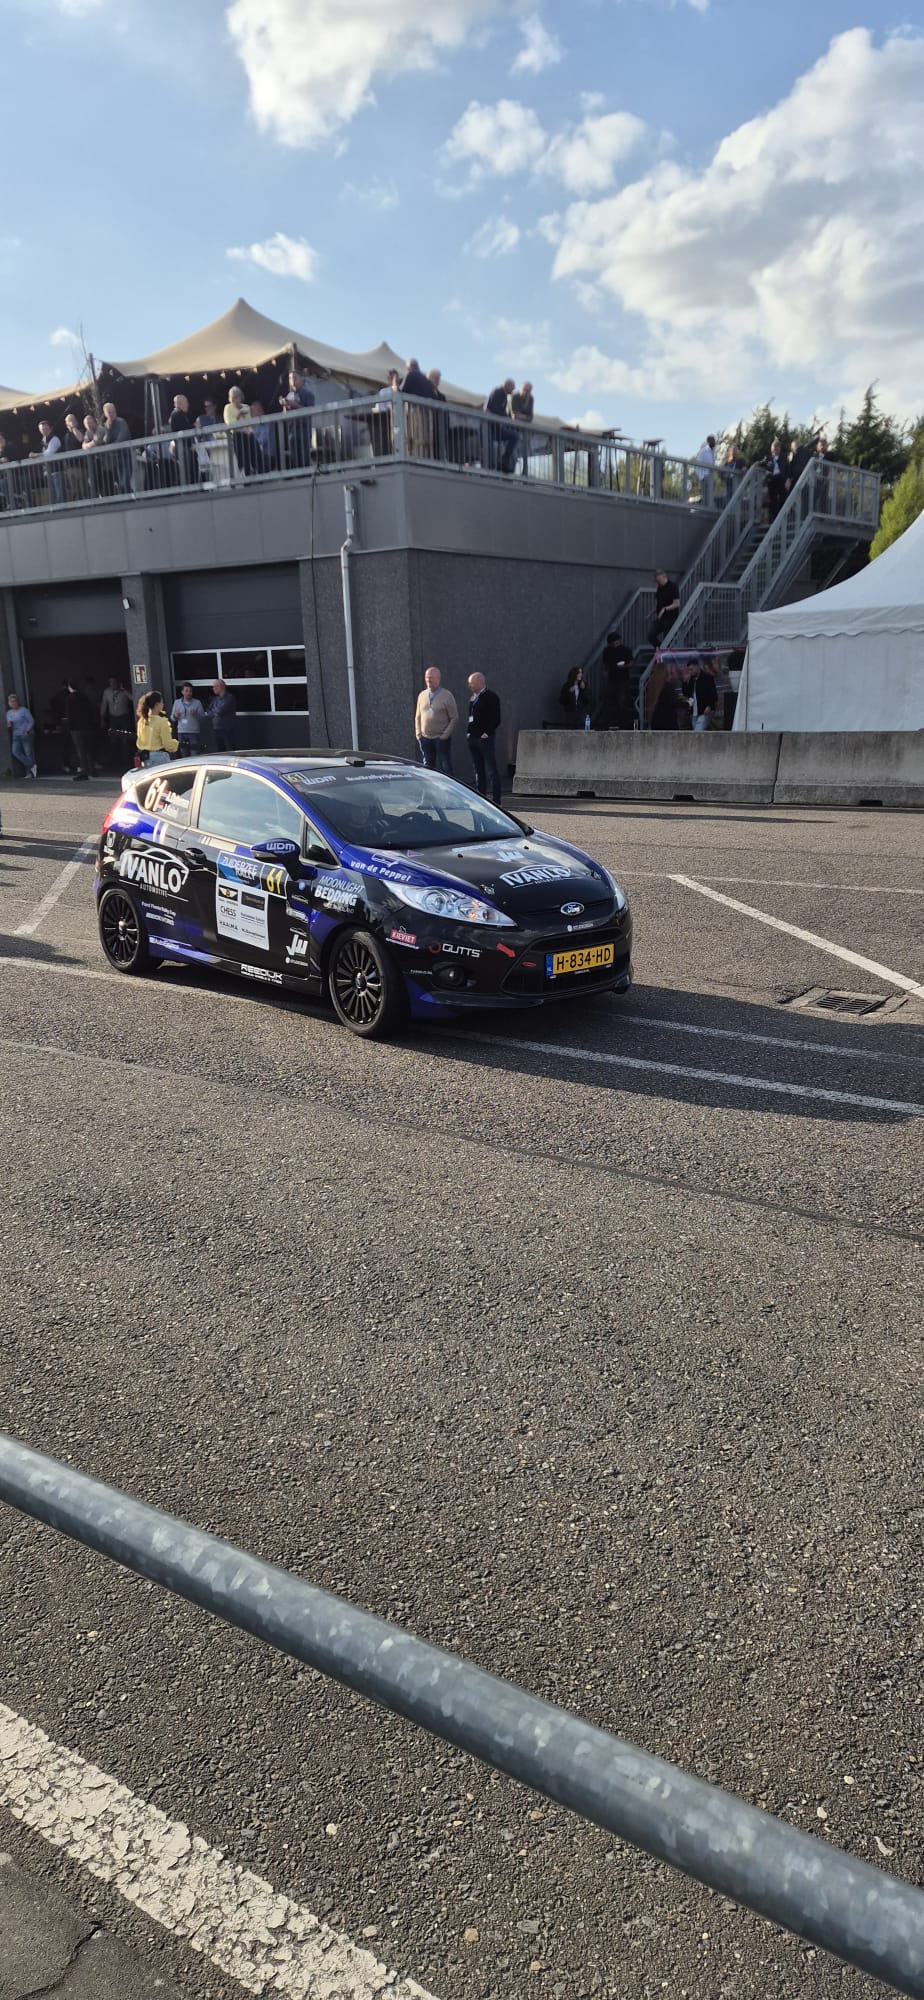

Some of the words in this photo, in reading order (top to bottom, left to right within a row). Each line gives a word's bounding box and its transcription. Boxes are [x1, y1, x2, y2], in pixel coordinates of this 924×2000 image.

[144, 777, 168, 811] 61
[119, 853, 181, 893] IVANLO
[221, 856, 259, 873] ZUIDERZEE
[234, 867, 258, 880] RALLY
[350, 860, 366, 870] van
[367, 864, 378, 873] de
[379, 867, 411, 882] Peppel
[266, 868, 284, 894] 61
[318, 875, 365, 894] MOONLIGHT
[503, 867, 571, 886] IVANLO
[314, 885, 358, 907] BEDDING
[220, 905, 237, 917] CHESS
[567, 904, 581, 913] Ford
[442, 943, 481, 958] GUTTS
[556, 947, 611, 970] H-834-HD
[241, 963, 283, 980] REEDIJK
